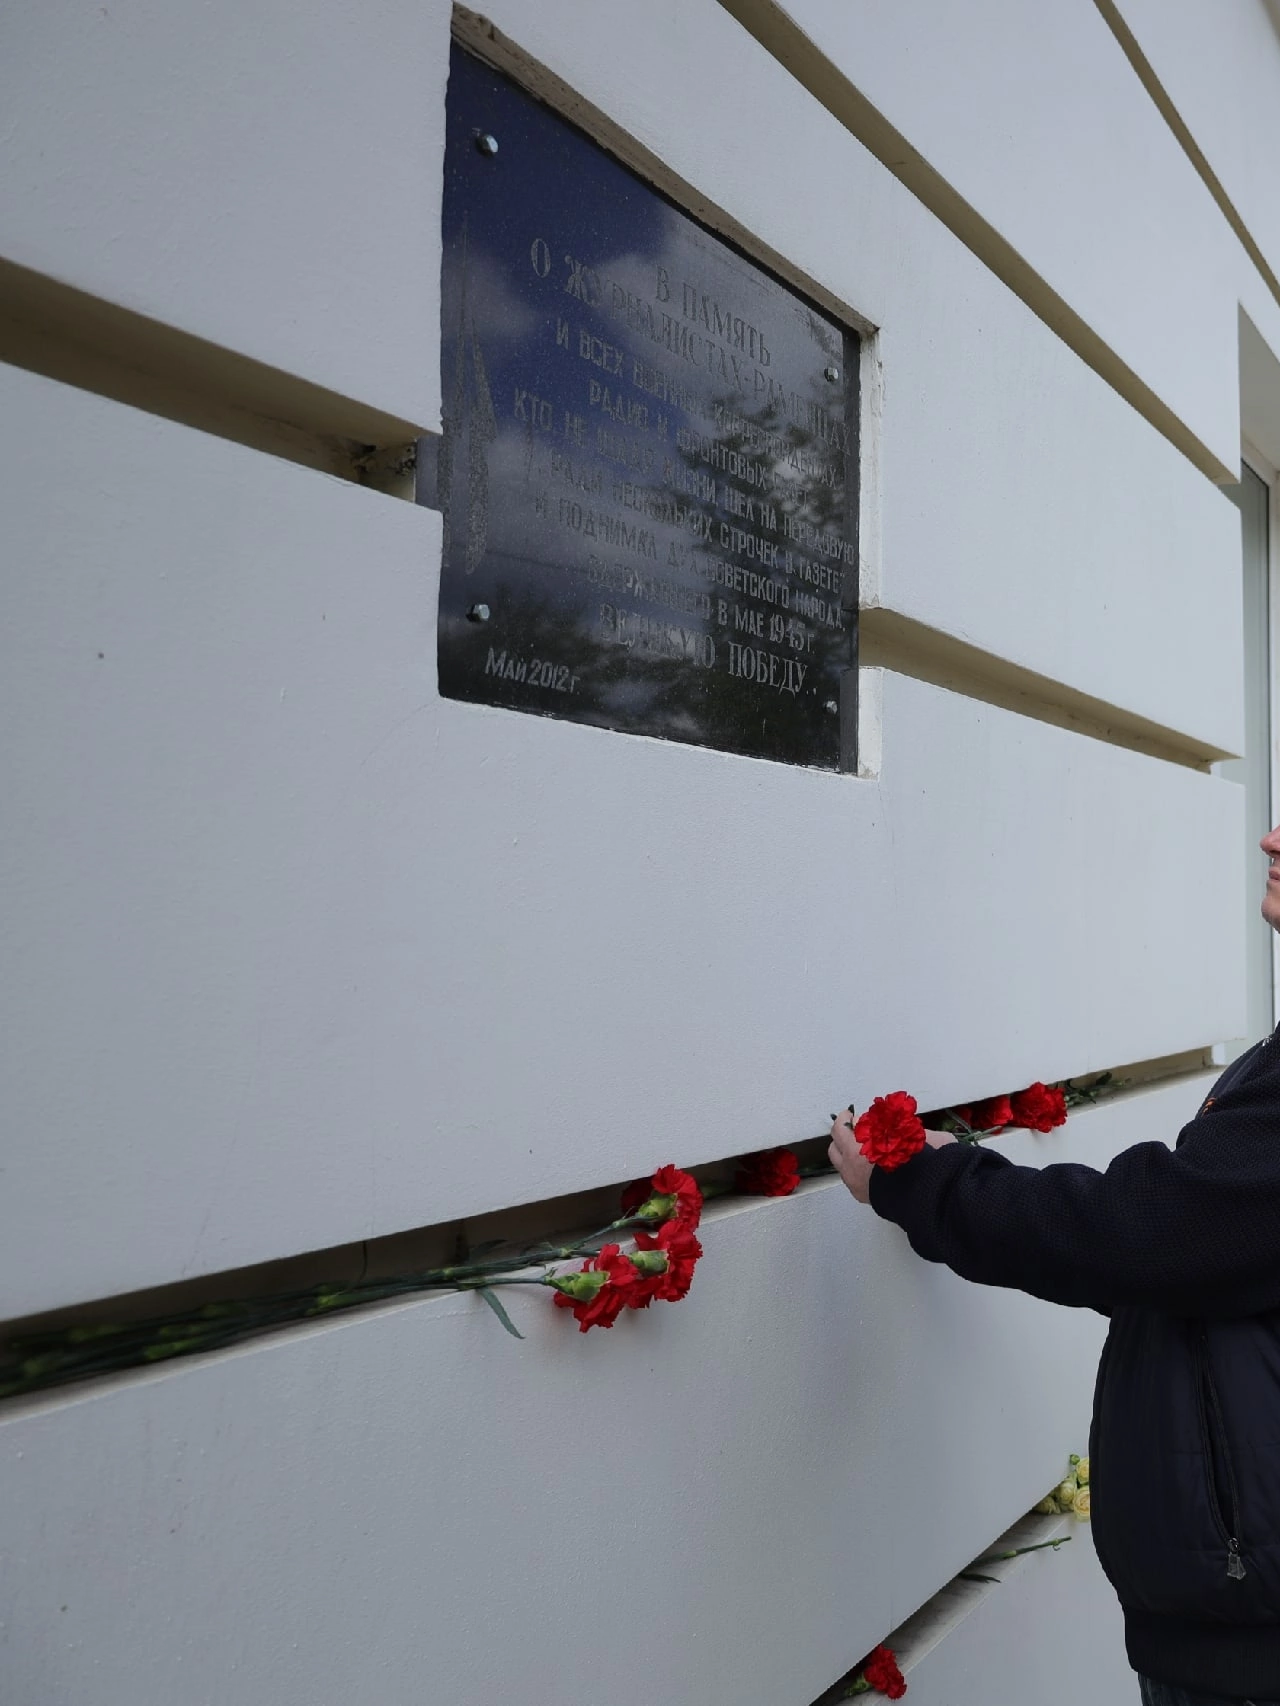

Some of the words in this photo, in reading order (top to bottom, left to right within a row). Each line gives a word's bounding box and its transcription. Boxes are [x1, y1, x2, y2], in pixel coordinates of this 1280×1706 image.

[530, 235, 551, 280] О
[656, 265, 670, 304] В
[683, 283, 771, 367] ПАМЯТЬ
[556, 319, 568, 349] И
[579, 330, 624, 377] ВСЕХ
[632, 360, 707, 421] ВОЕННЫХ
[714, 404, 836, 489] КОРРЕСПОНДЕНТАХ
[589, 380, 648, 434] РАДИО
[657, 416, 667, 442] И
[677, 425, 766, 489] ФРОНТОВЫХ
[565, 414, 587, 447] НЕ
[724, 486, 754, 521] ШЕЛ
[760, 504, 777, 531] НА
[783, 514, 854, 566] ПЕРЕДОВУЮ
[612, 477, 712, 541] НЕСКОЛЬКИХ
[719, 523, 778, 568] СТРОЧЕК
[785, 551, 793, 574] В
[535, 489, 548, 520] И
[667, 539, 699, 575] ДУХ
[705, 556, 789, 608] СОВЕТСКОГО
[598, 604, 715, 670] ВЕЛИКУЮ
[717, 601, 727, 625] В
[734, 606, 764, 637] МАЕ
